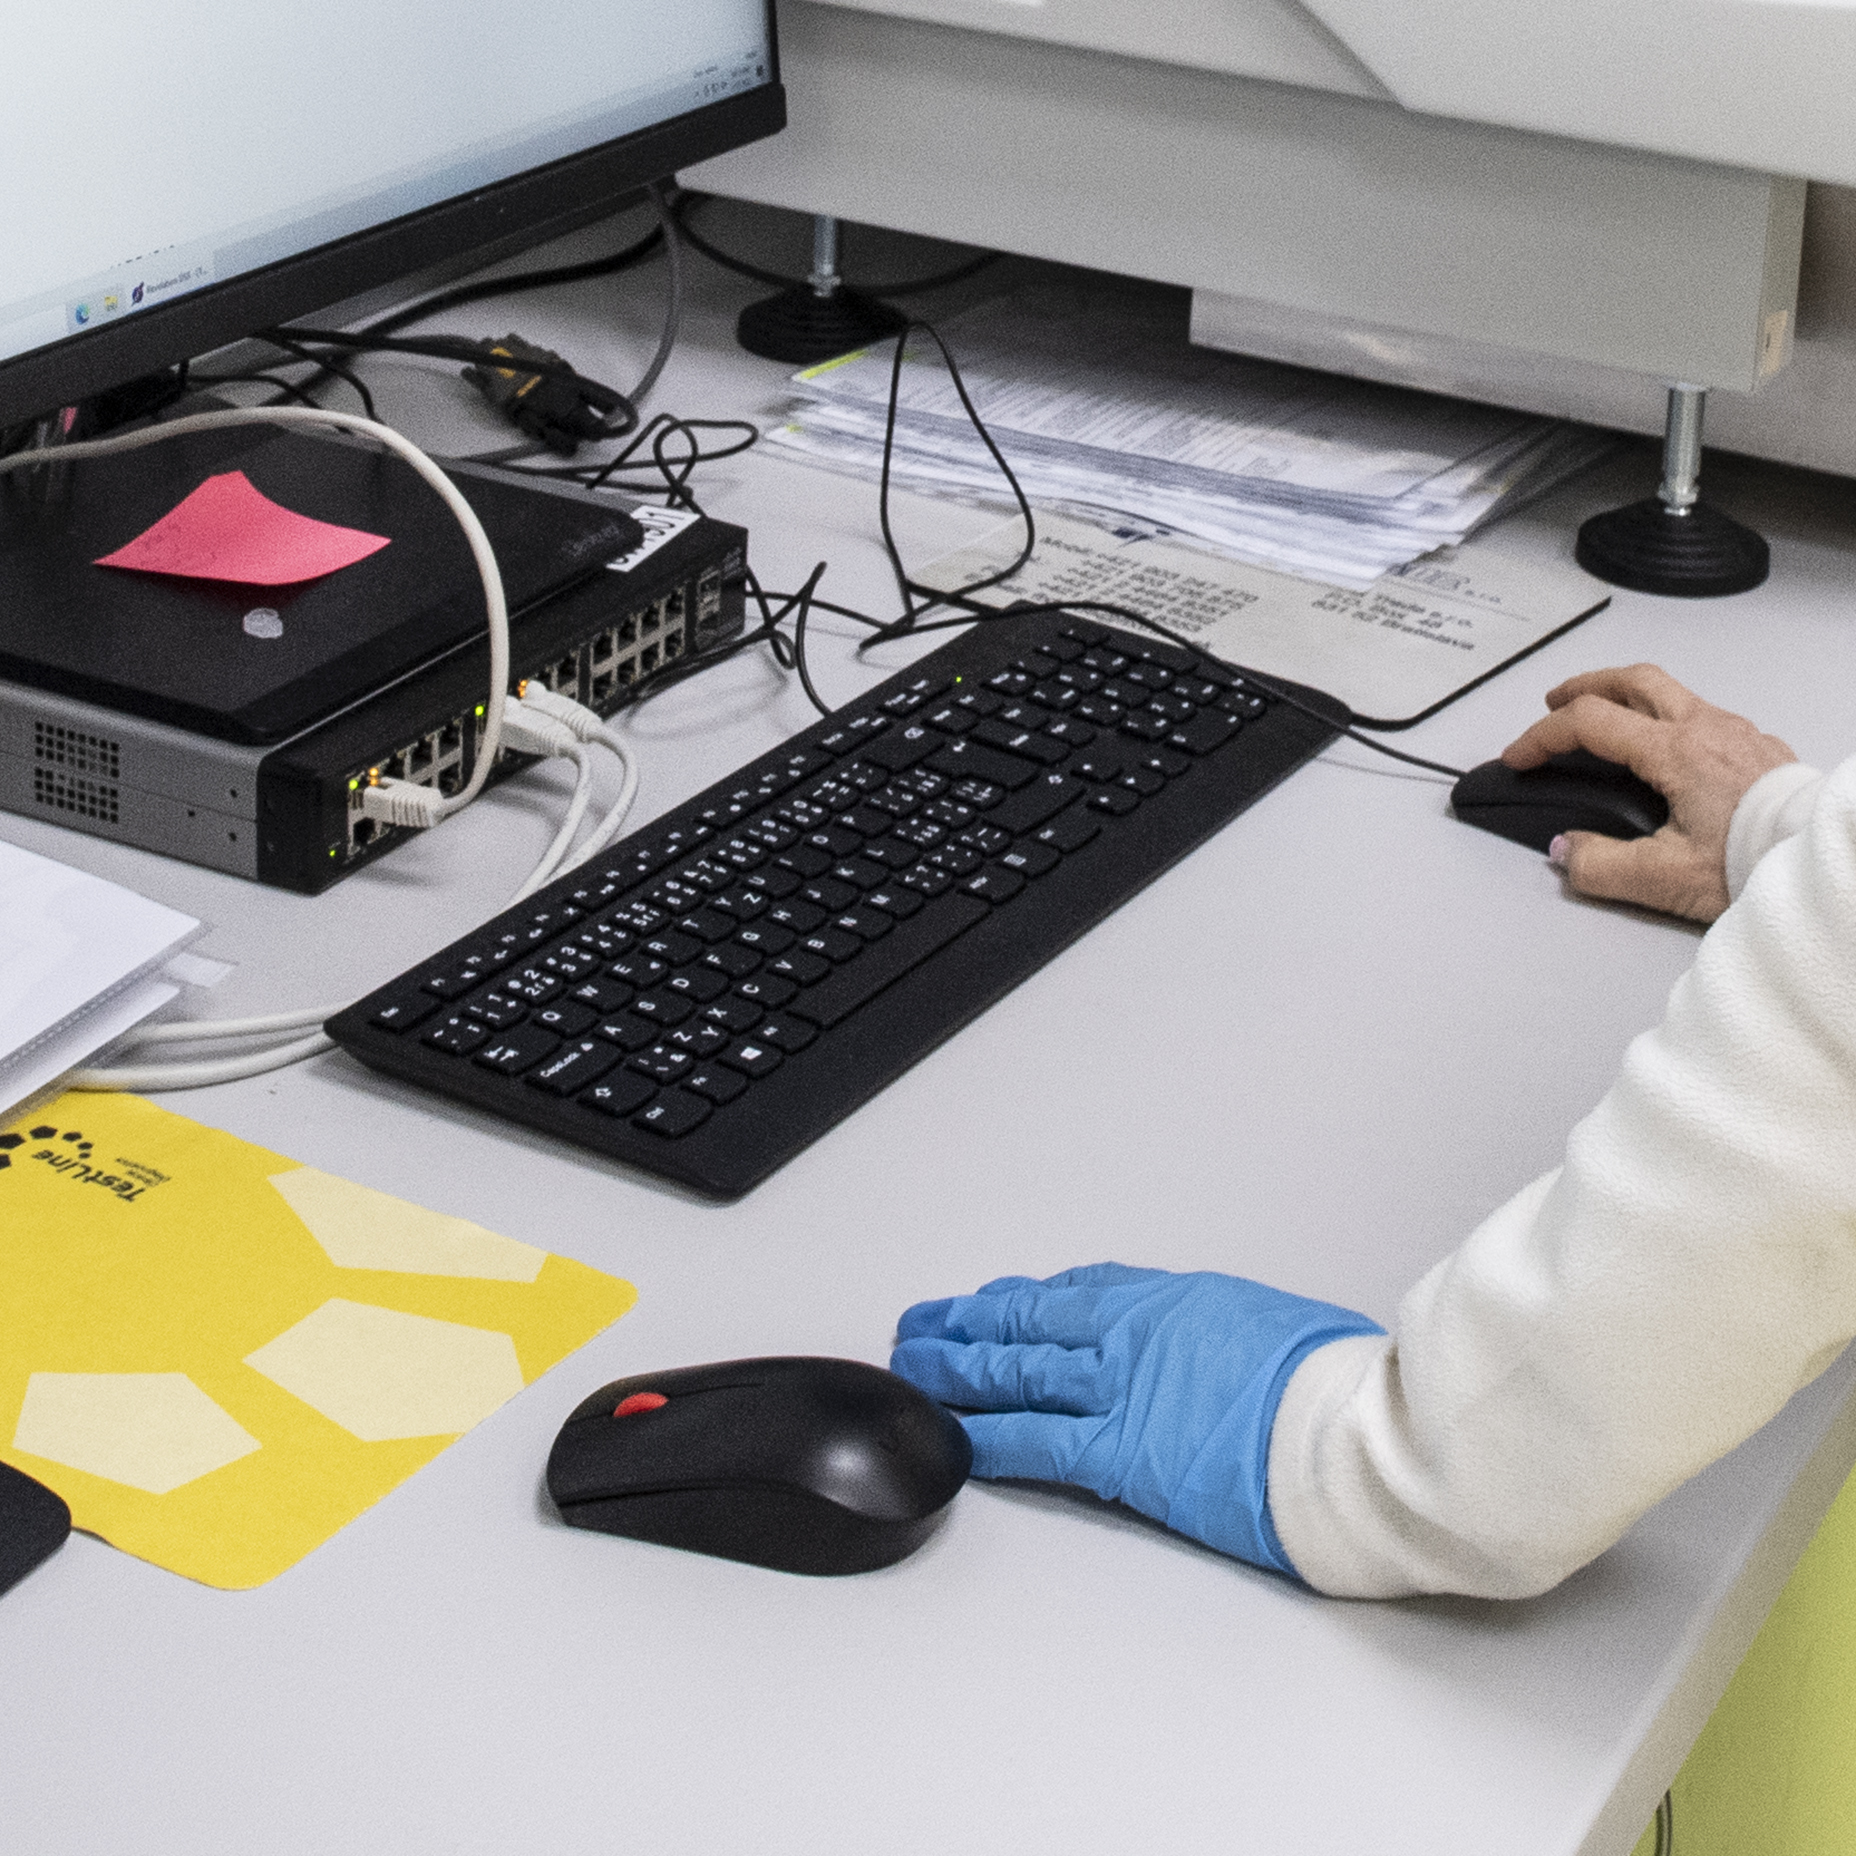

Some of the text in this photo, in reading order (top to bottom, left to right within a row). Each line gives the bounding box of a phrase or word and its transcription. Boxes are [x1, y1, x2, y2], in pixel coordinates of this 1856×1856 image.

[672, 977, 690, 989] D
[742, 983, 760, 994] C
[707, 1007, 728, 1018] X
[604, 1025, 622, 1036] A
[673, 1030, 692, 1042] Z
[32, 1149, 146, 1202] TestLine
